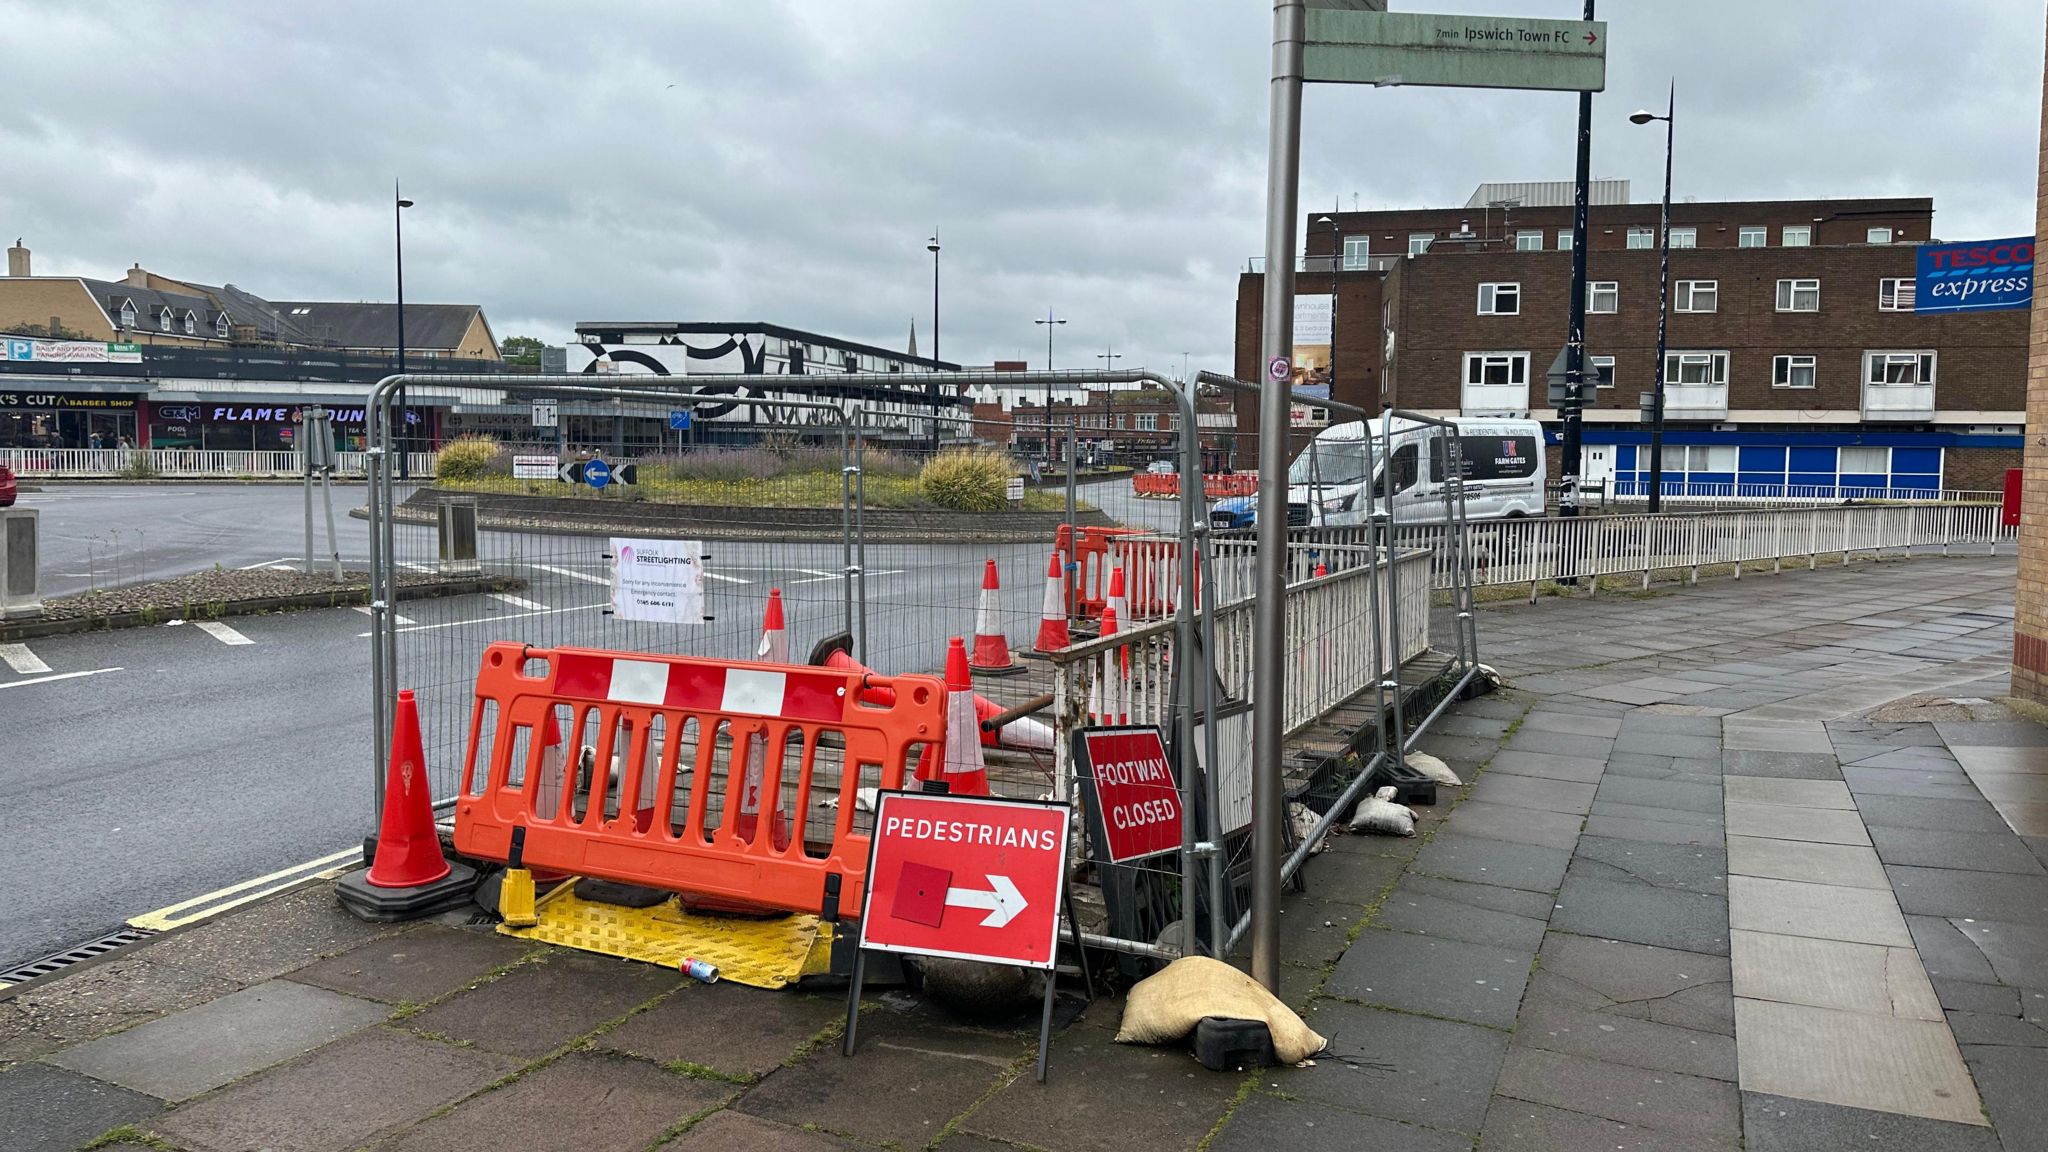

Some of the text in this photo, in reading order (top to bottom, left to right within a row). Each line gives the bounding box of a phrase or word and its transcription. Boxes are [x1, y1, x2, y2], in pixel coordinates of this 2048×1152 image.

[1436, 27, 1569, 43] 7min Ipswich Town FC
[1928, 243, 2035, 269] TESCO
[1932, 277, 2028, 300] express
[26, 395, 56, 405] CUT
[213, 407, 287, 421] FLAME
[1469, 428, 1534, 436] RESIDENTIAL INDUSTRIAL
[1502, 440, 1517, 456] UK
[1494, 456, 1526, 465] FARM GATES
[636, 548, 659, 556] SUFFOLK
[636, 555, 692, 565] STREETLIGHTING
[631, 589, 656, 597] Emergency
[1096, 758, 1166, 787] FOOTWAY
[1113, 798, 1175, 830] CLOSED
[885, 816, 1055, 851] PEDESTRIANS
